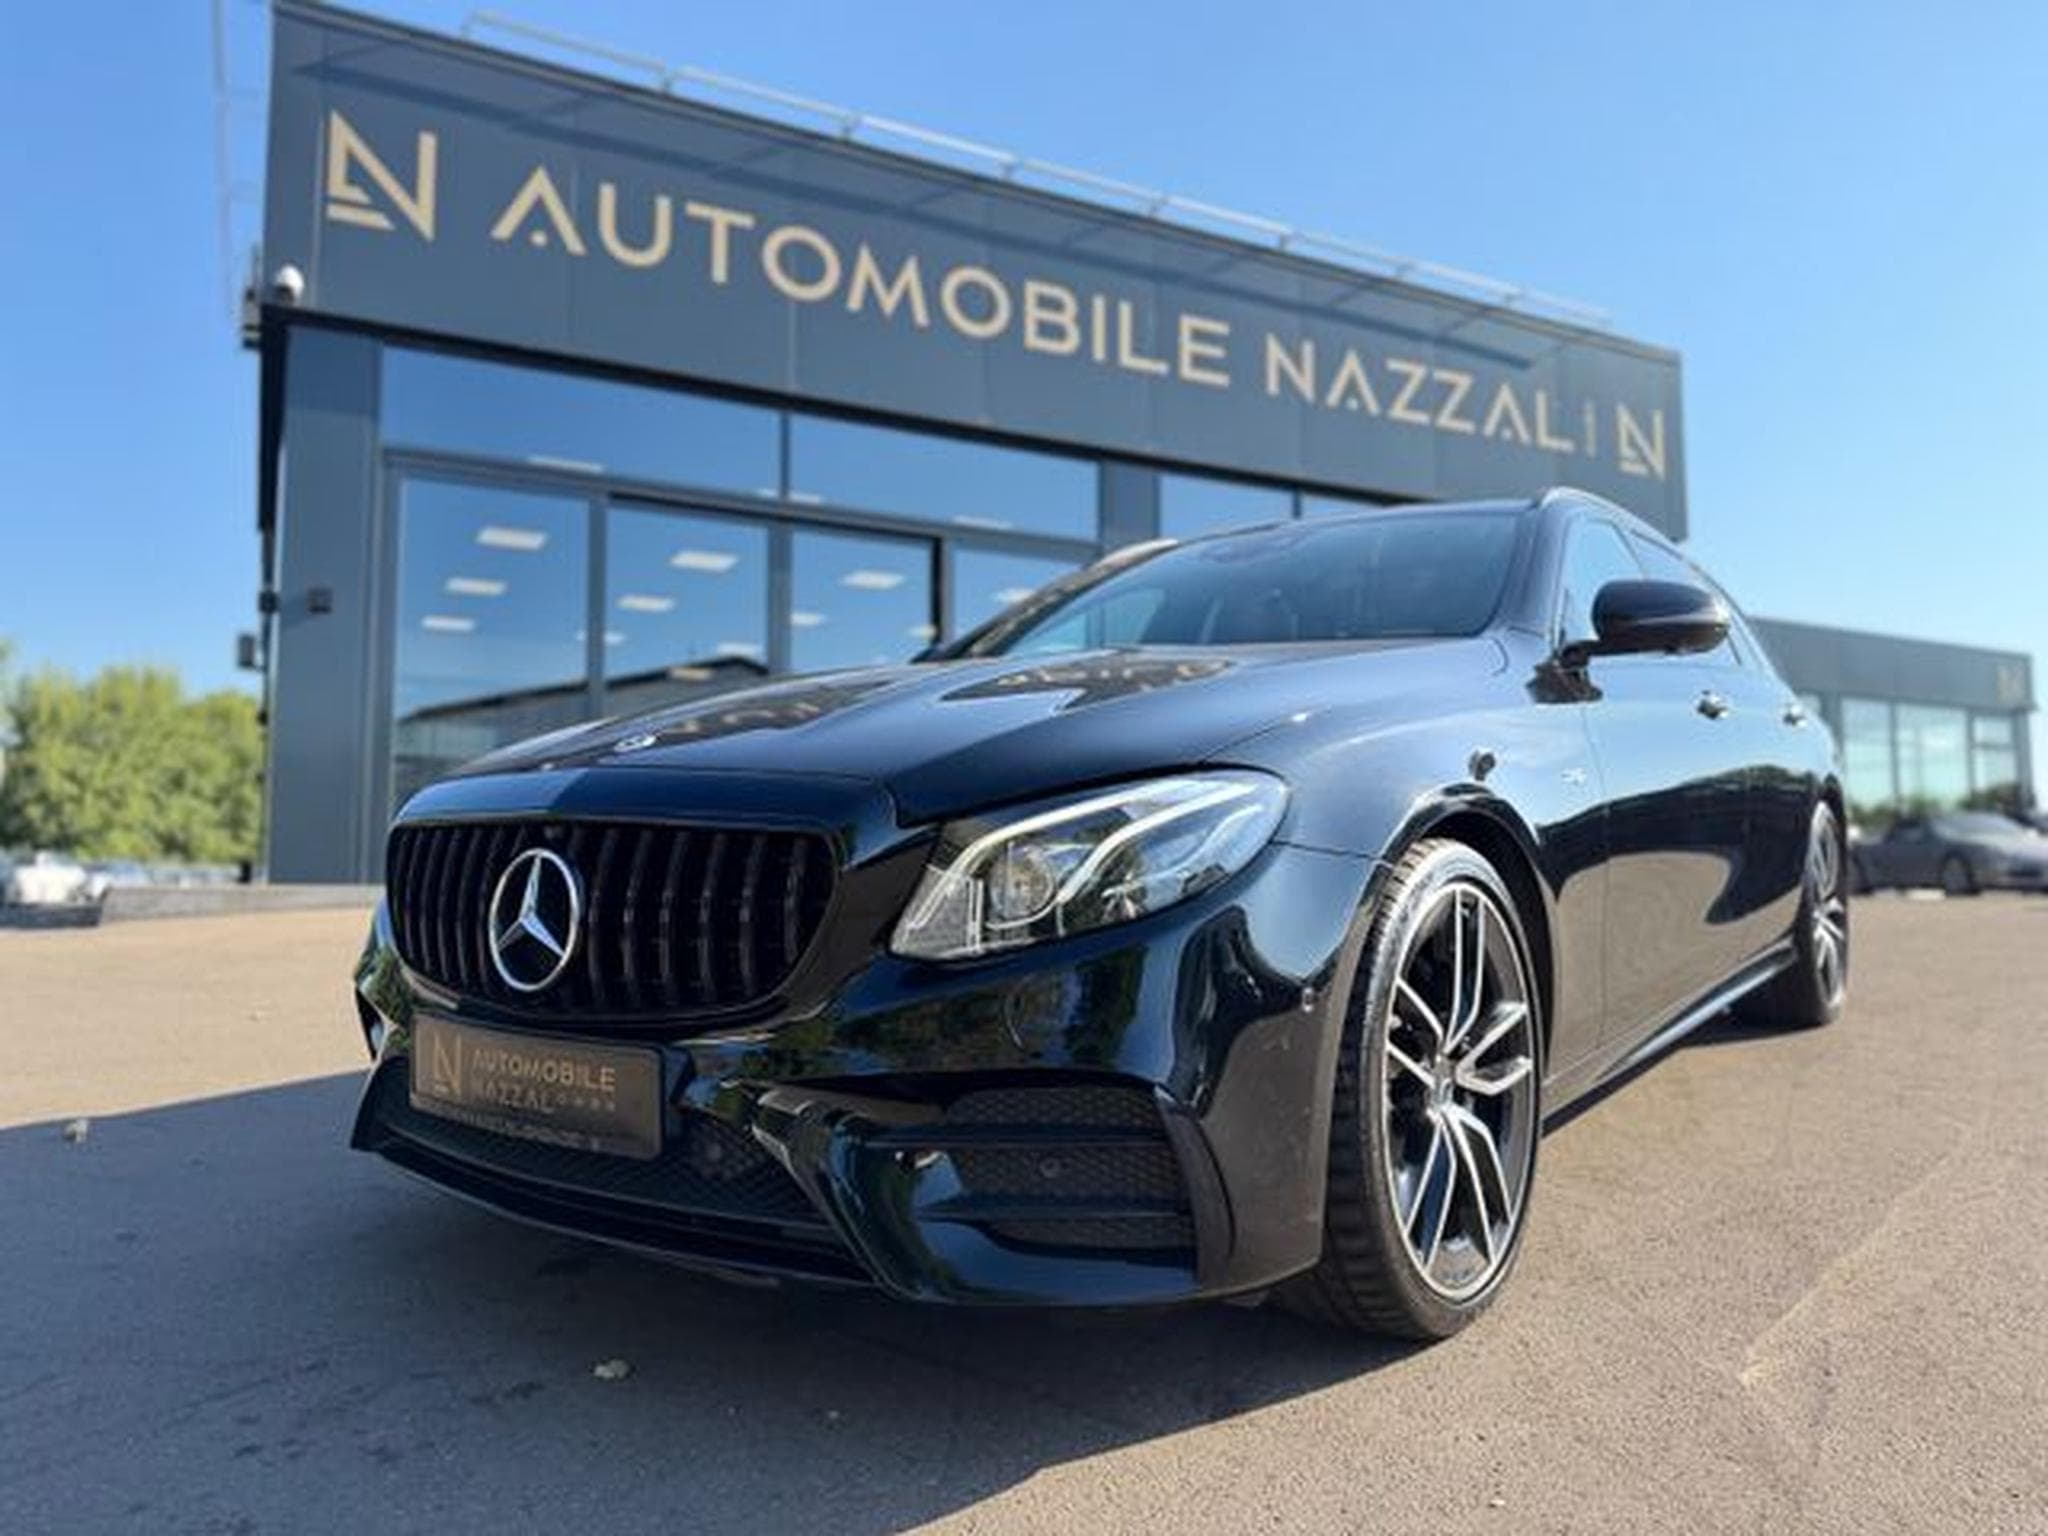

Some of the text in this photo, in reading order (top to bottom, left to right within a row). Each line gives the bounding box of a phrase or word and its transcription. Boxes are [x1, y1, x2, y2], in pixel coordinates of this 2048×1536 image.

[490, 164, 1232, 388] AUTOMOBILE
[1264, 332, 1575, 454] NAZZAL
[470, 1048, 616, 1093] AUTOMOBILE
